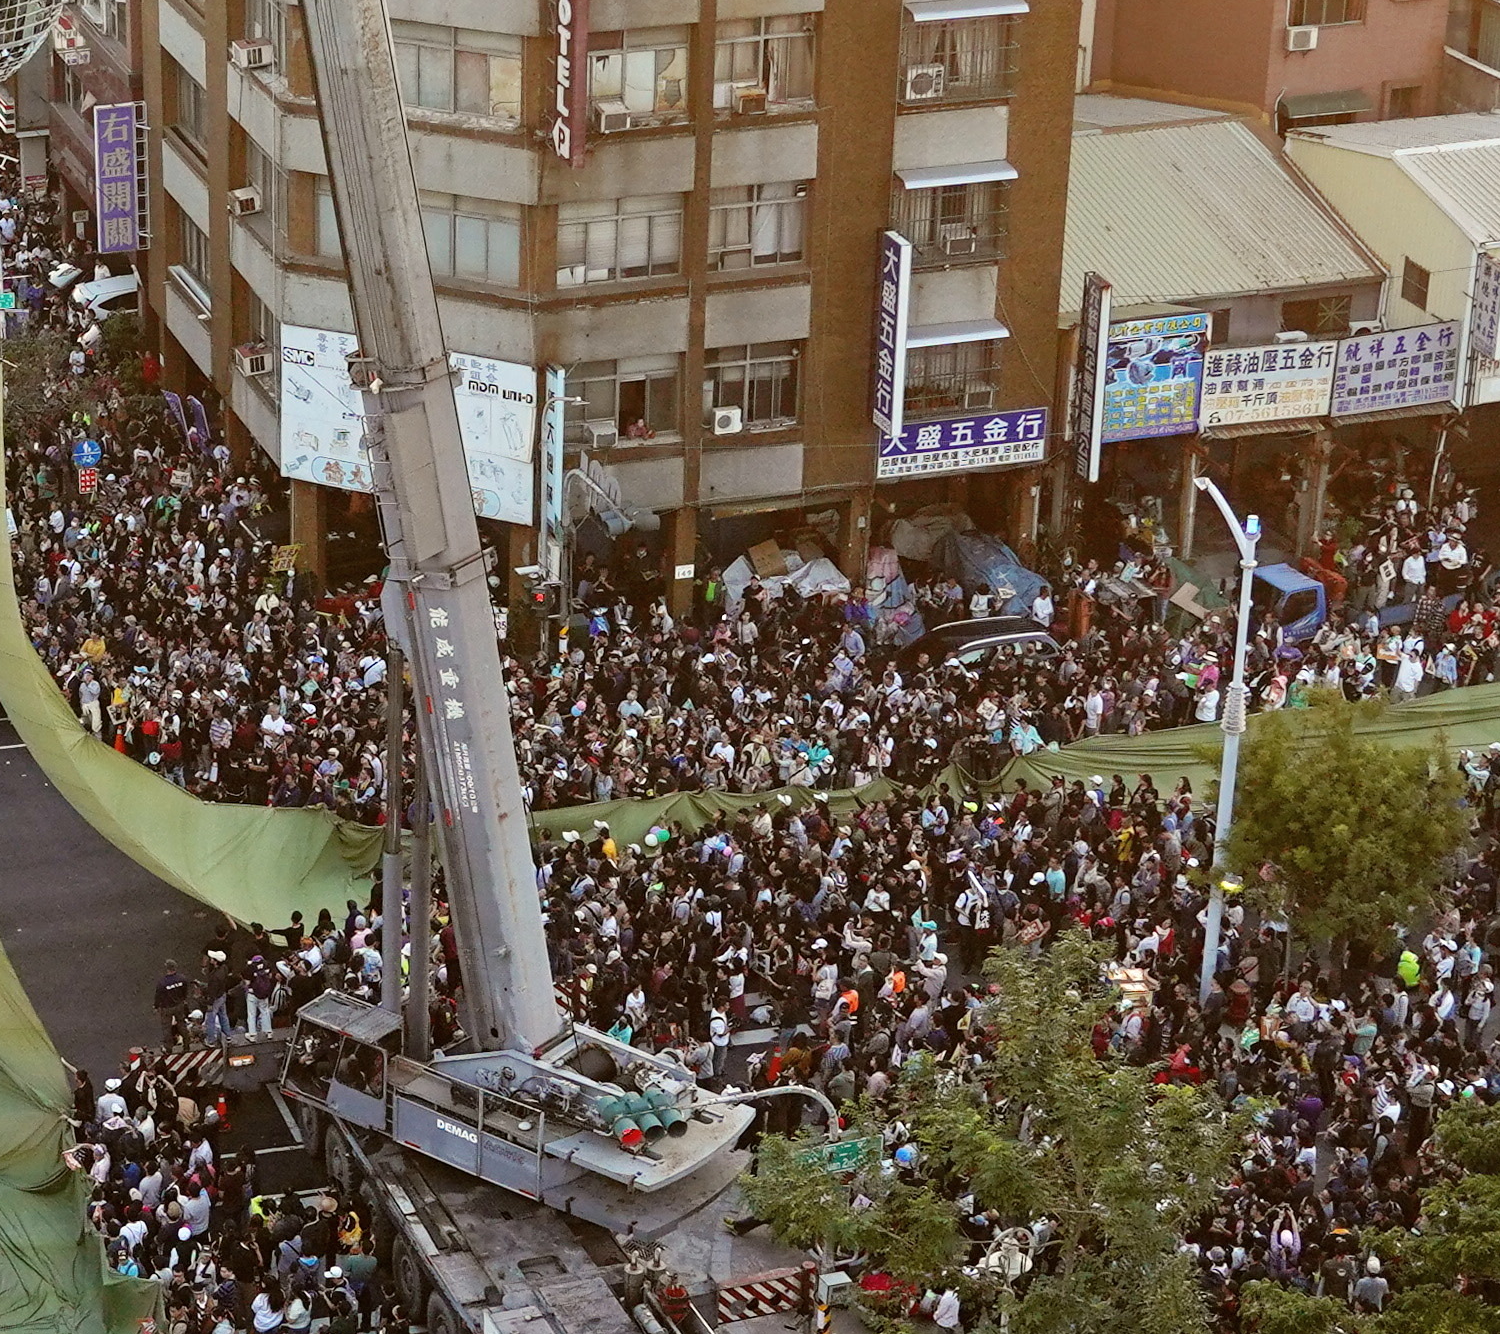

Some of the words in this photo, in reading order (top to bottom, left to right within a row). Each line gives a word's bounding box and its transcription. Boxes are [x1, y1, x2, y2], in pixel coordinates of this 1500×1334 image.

[103, 112, 133, 248] 右盛開關
[875, 247, 899, 415] 大盛五金行
[283, 347, 315, 367] SMC
[1240, 391, 1279, 406] 千斤頂
[882, 412, 1043, 455] 大盛五金行
[436, 1118, 479, 1144] DEMAG
